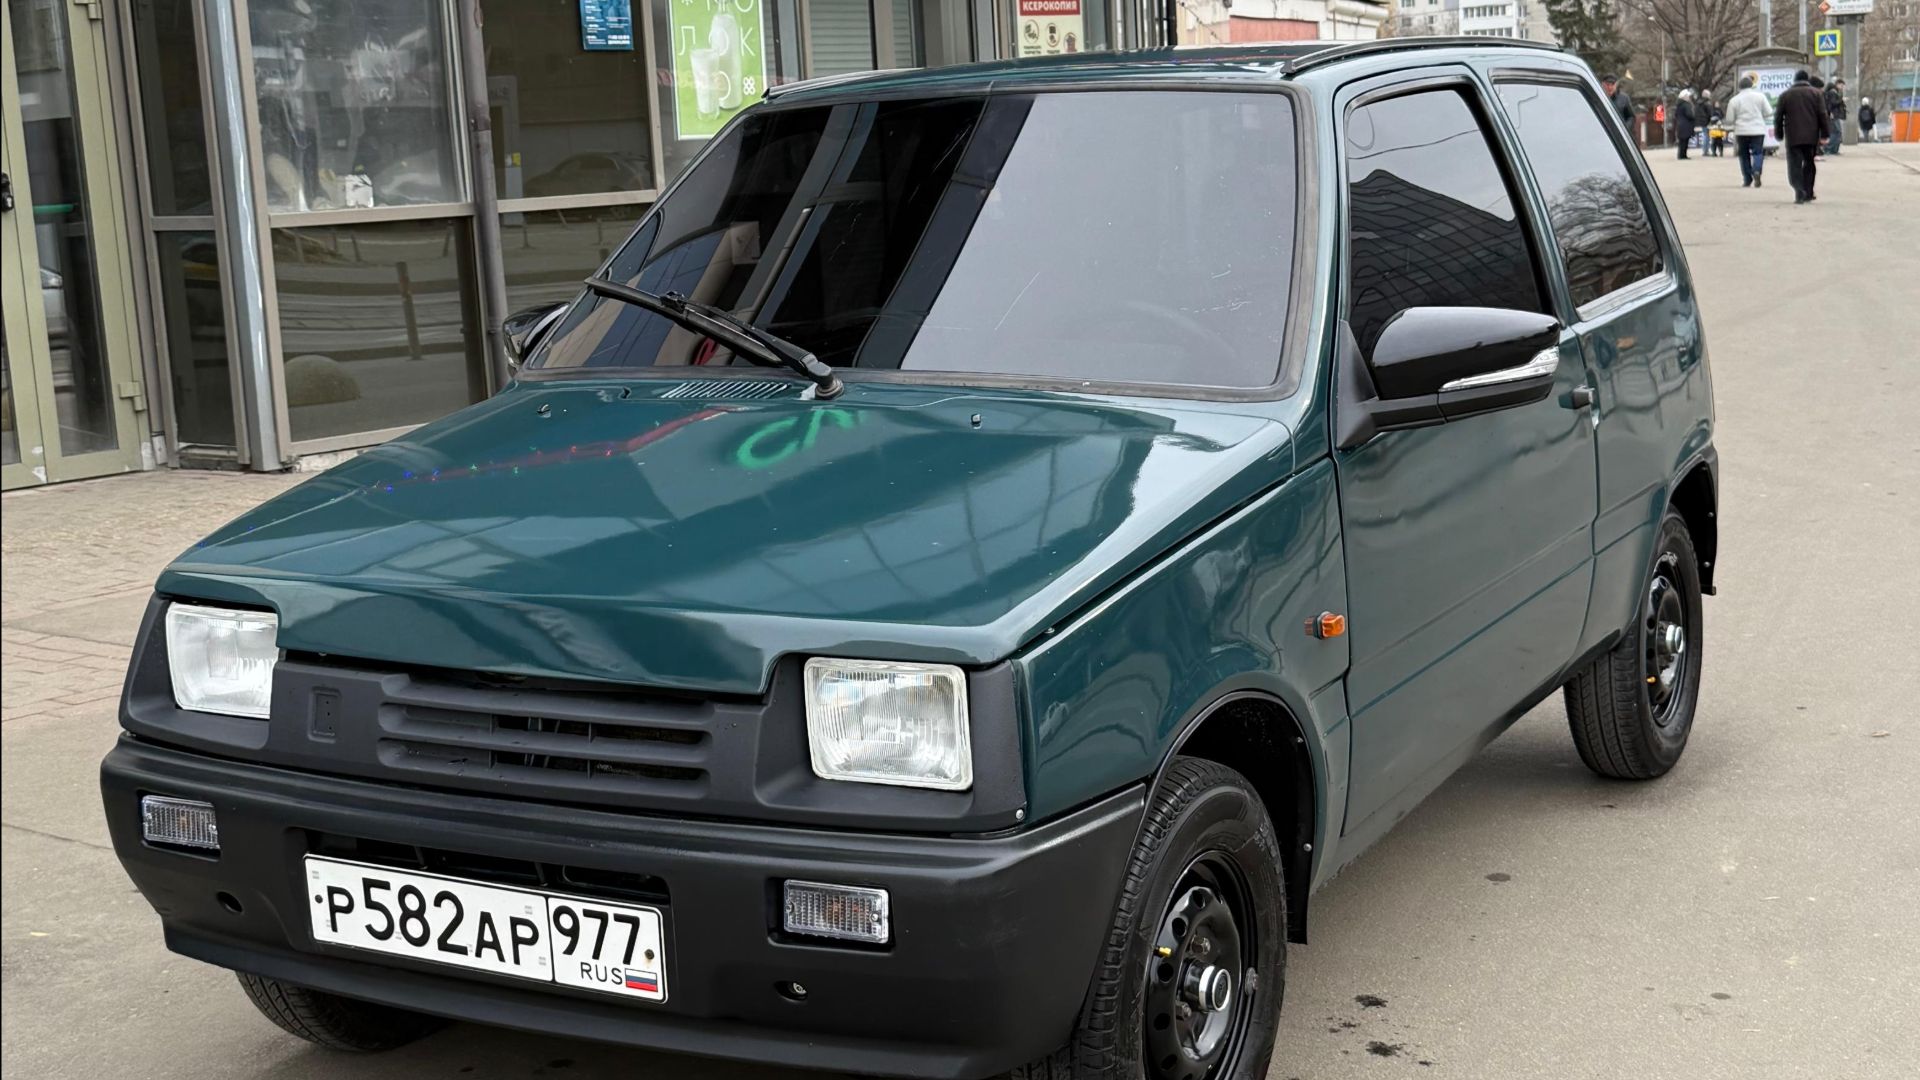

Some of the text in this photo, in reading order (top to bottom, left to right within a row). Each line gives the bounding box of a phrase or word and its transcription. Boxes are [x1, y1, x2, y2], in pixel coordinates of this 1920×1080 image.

[1023, 0, 1077, 11] КСЕРОКОПИЯ
[1760, 73, 1793, 83] супер
[552, 905, 641, 965] 977
[580, 962, 623, 985] RUS
